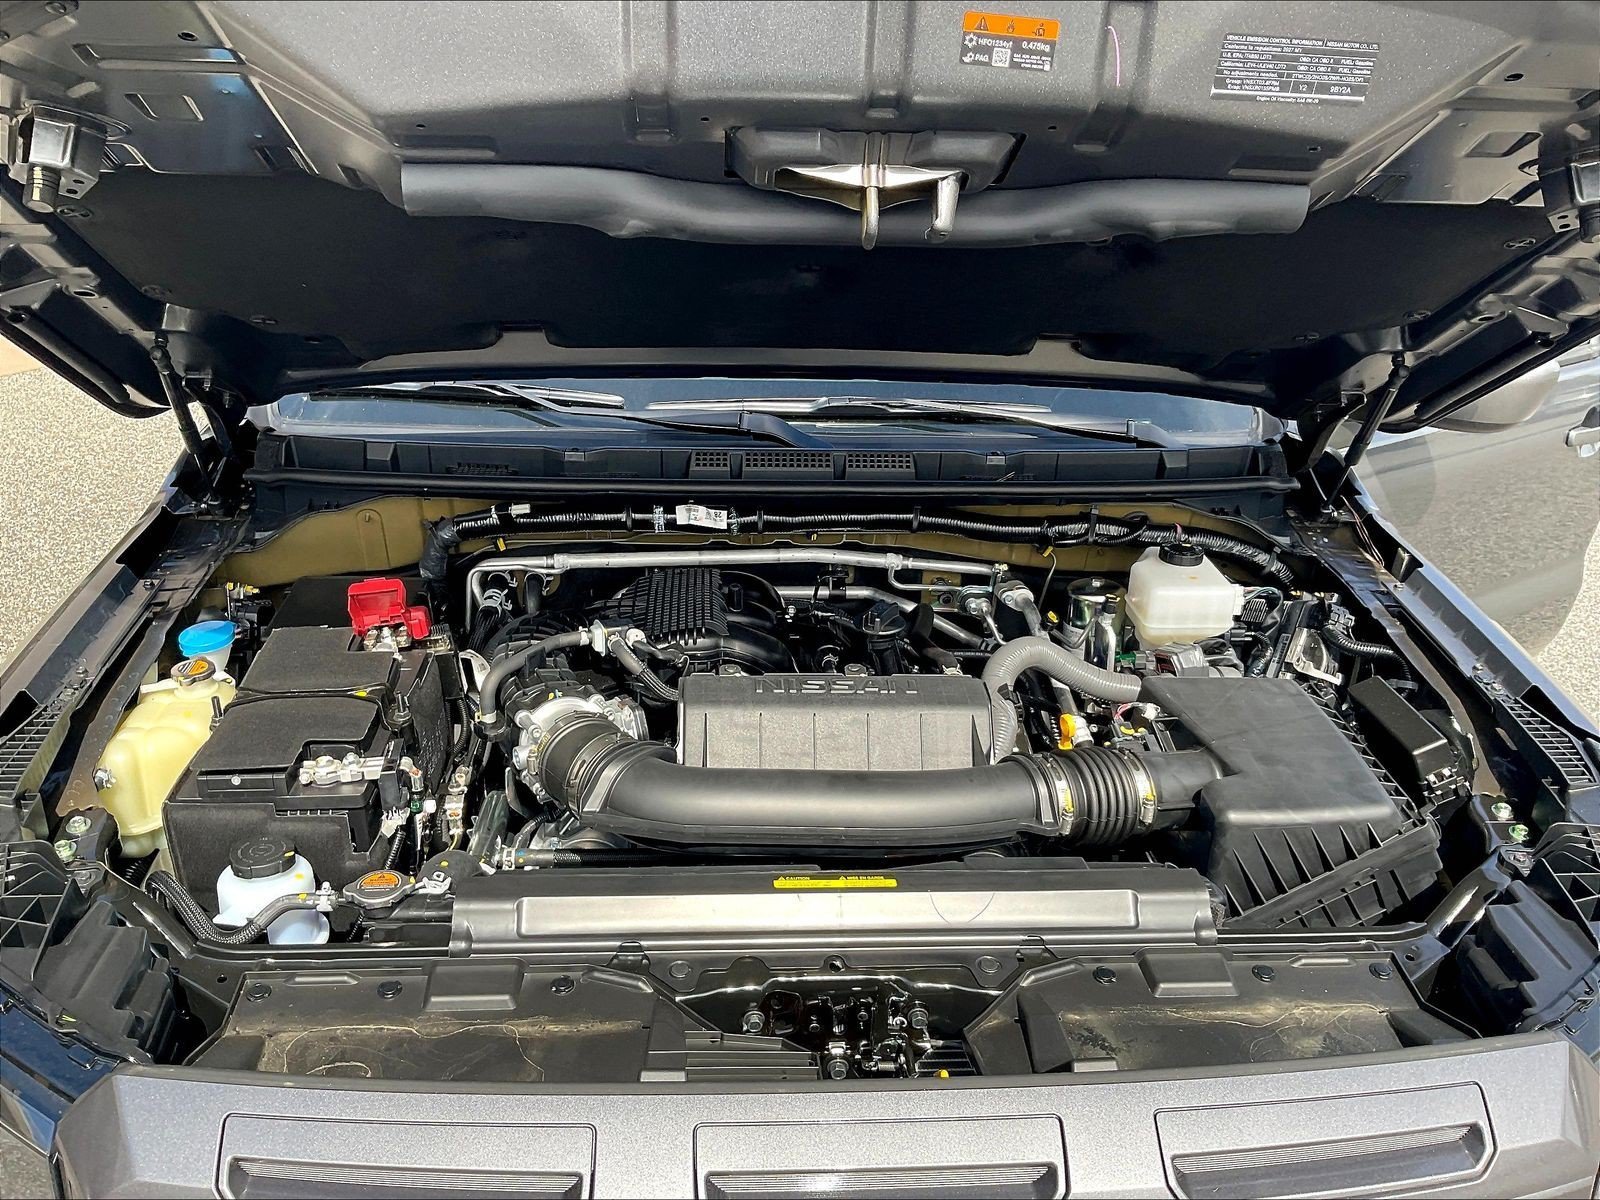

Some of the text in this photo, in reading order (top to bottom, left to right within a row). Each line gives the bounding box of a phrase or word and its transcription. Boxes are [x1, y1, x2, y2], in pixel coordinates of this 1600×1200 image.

[979, 38, 1050, 52] HFO1234yf 0.475kg
[975, 53, 989, 61] PAG
[755, 678, 918, 694] NISSAN
